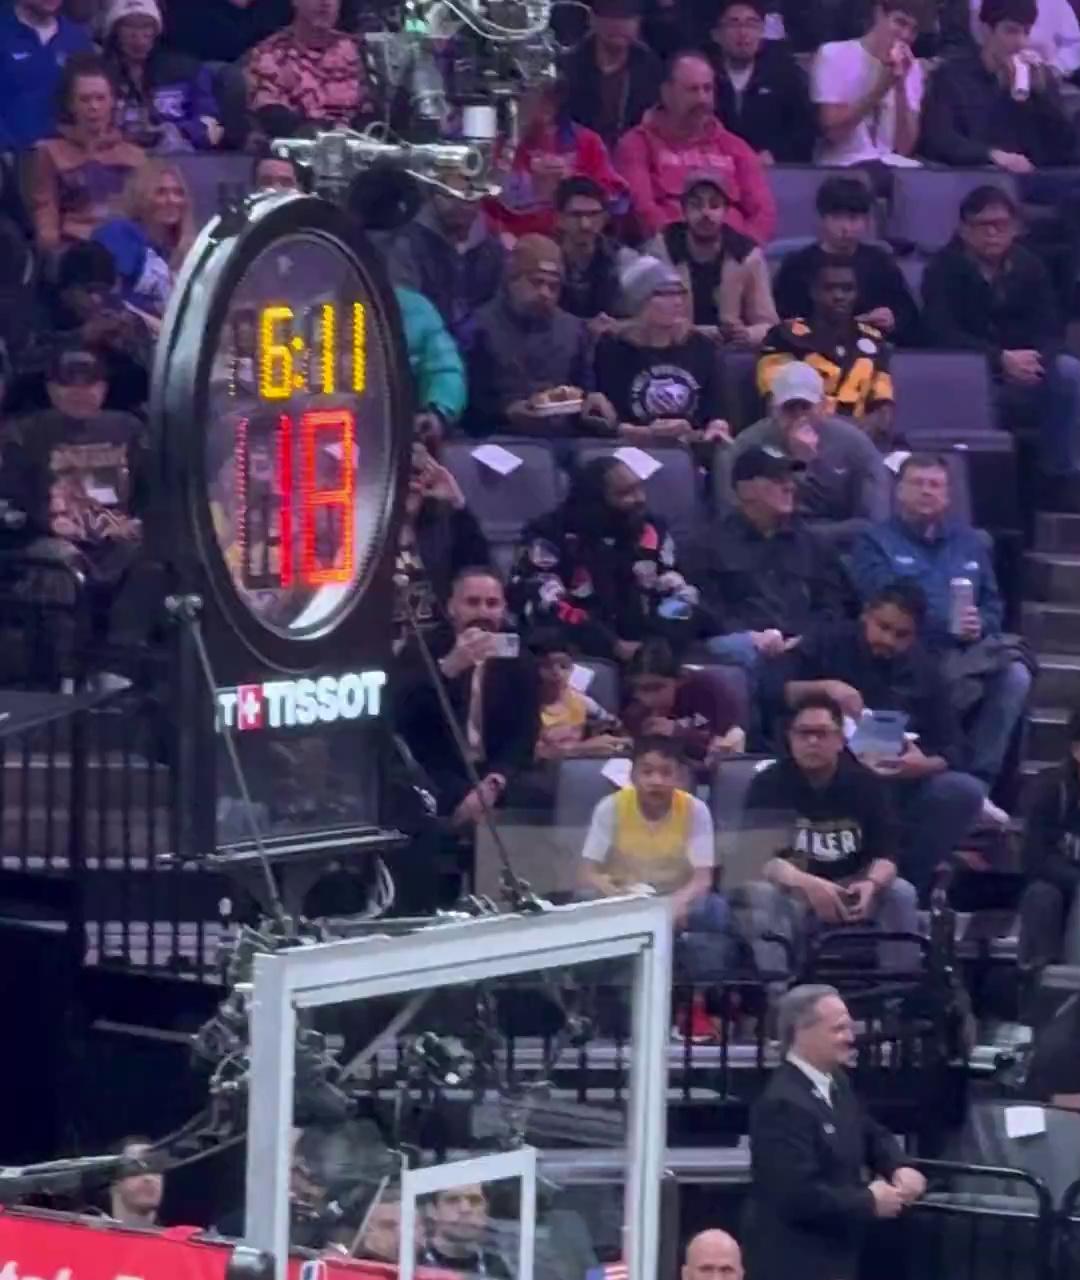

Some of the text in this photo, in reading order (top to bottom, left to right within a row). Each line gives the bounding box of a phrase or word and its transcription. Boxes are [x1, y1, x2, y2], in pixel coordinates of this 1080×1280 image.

[259, 302, 366, 399] 6:11
[278, 410, 355, 588] 18
[263, 670, 386, 728] TISSOT
